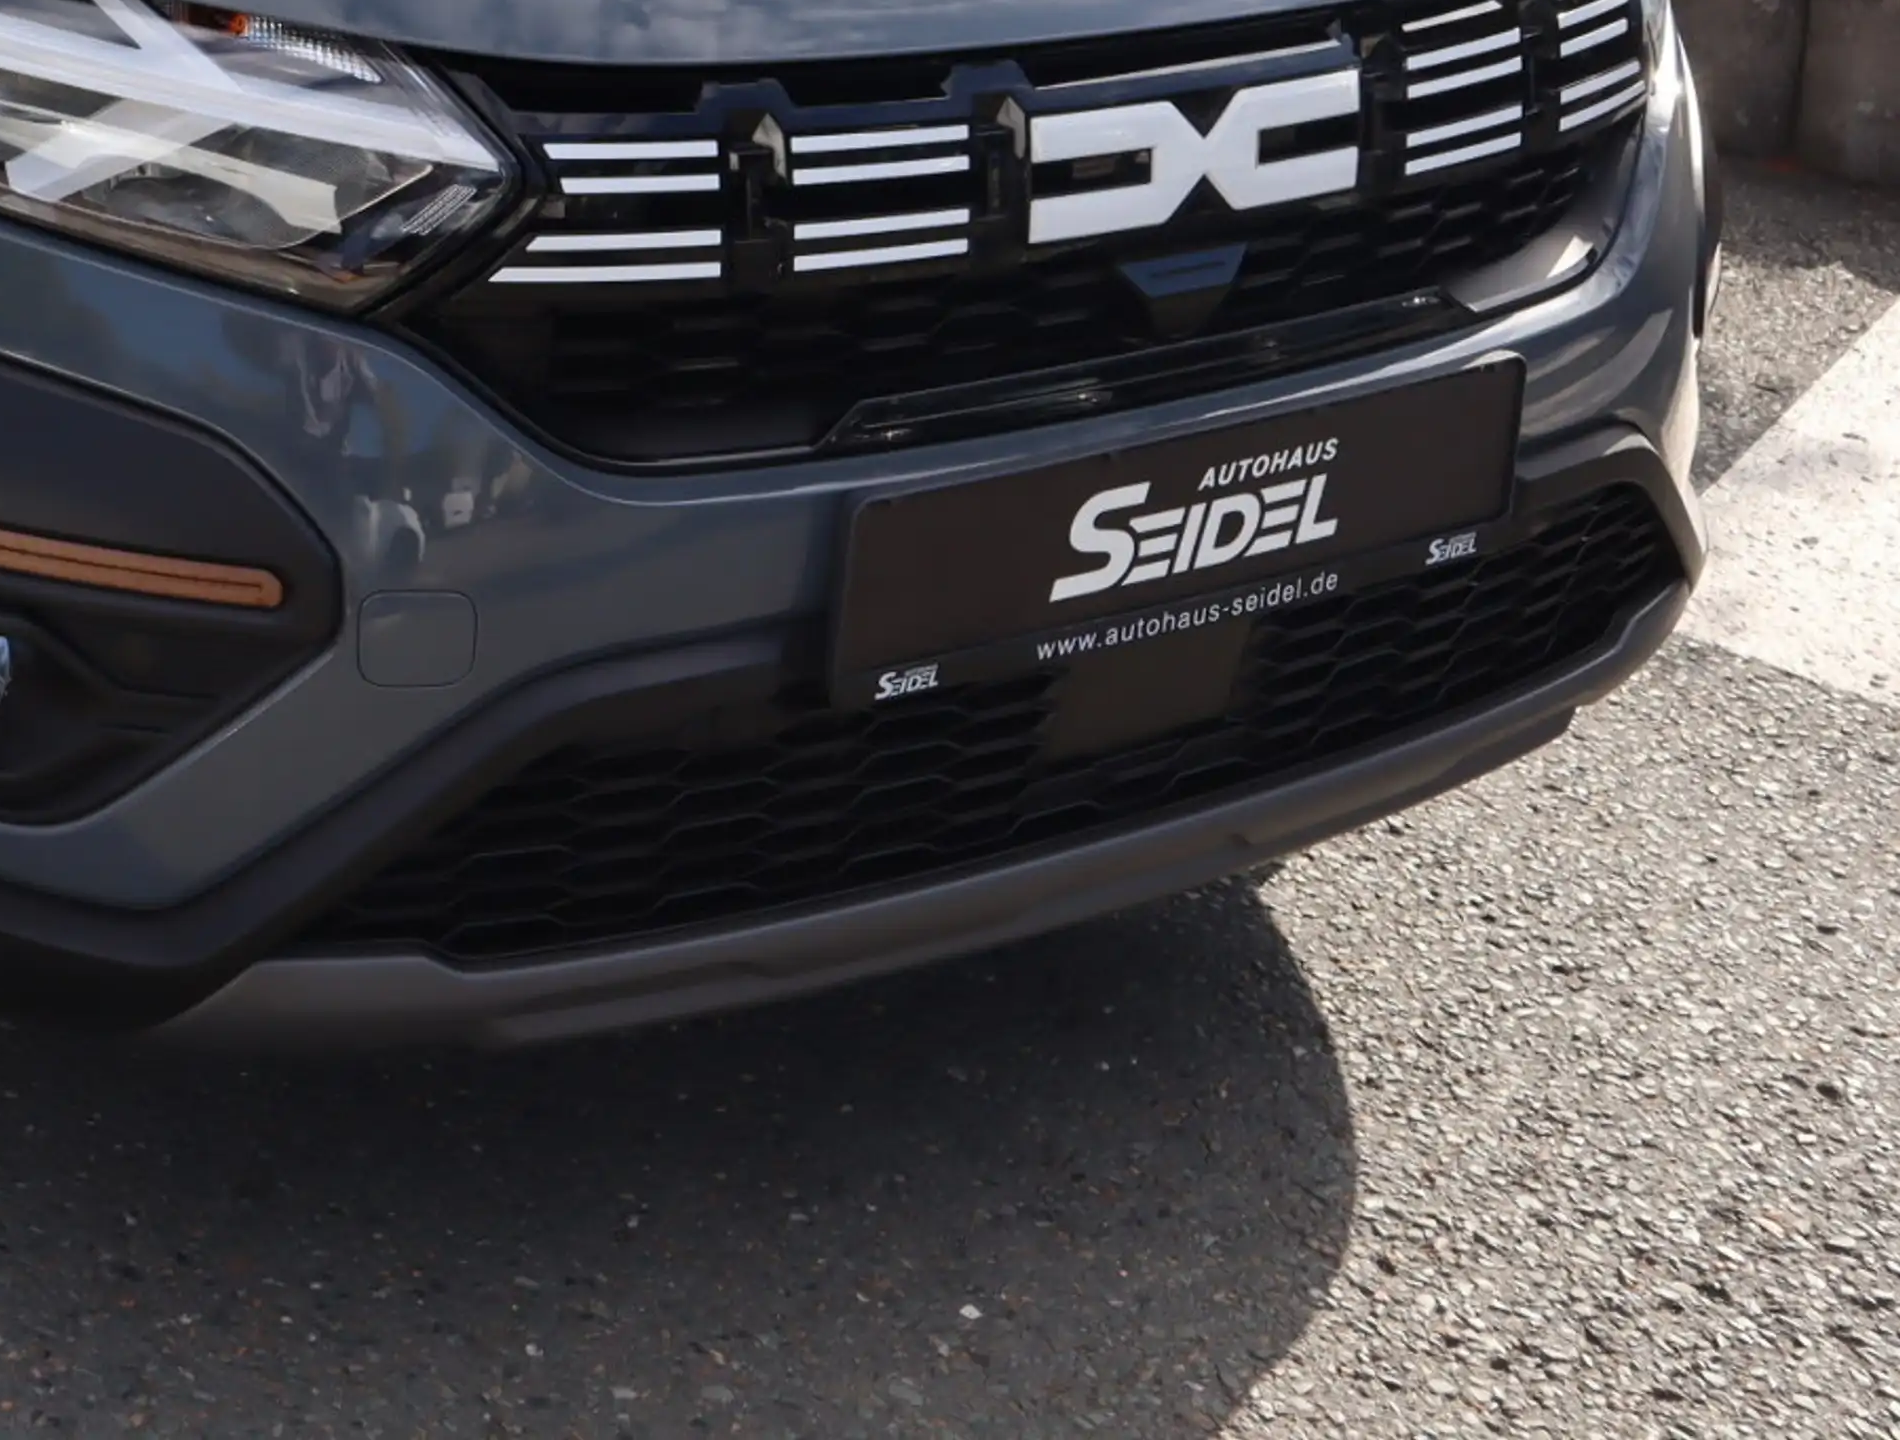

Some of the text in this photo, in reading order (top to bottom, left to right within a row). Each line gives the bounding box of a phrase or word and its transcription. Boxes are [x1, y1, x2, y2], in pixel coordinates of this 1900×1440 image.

[1197, 437, 1340, 492] AUTOHAUS
[1049, 473, 1339, 603] SEIDEL
[1035, 571, 1339, 661] www.autohaus-seidel.de
[874, 668, 939, 701] SEIDEL
